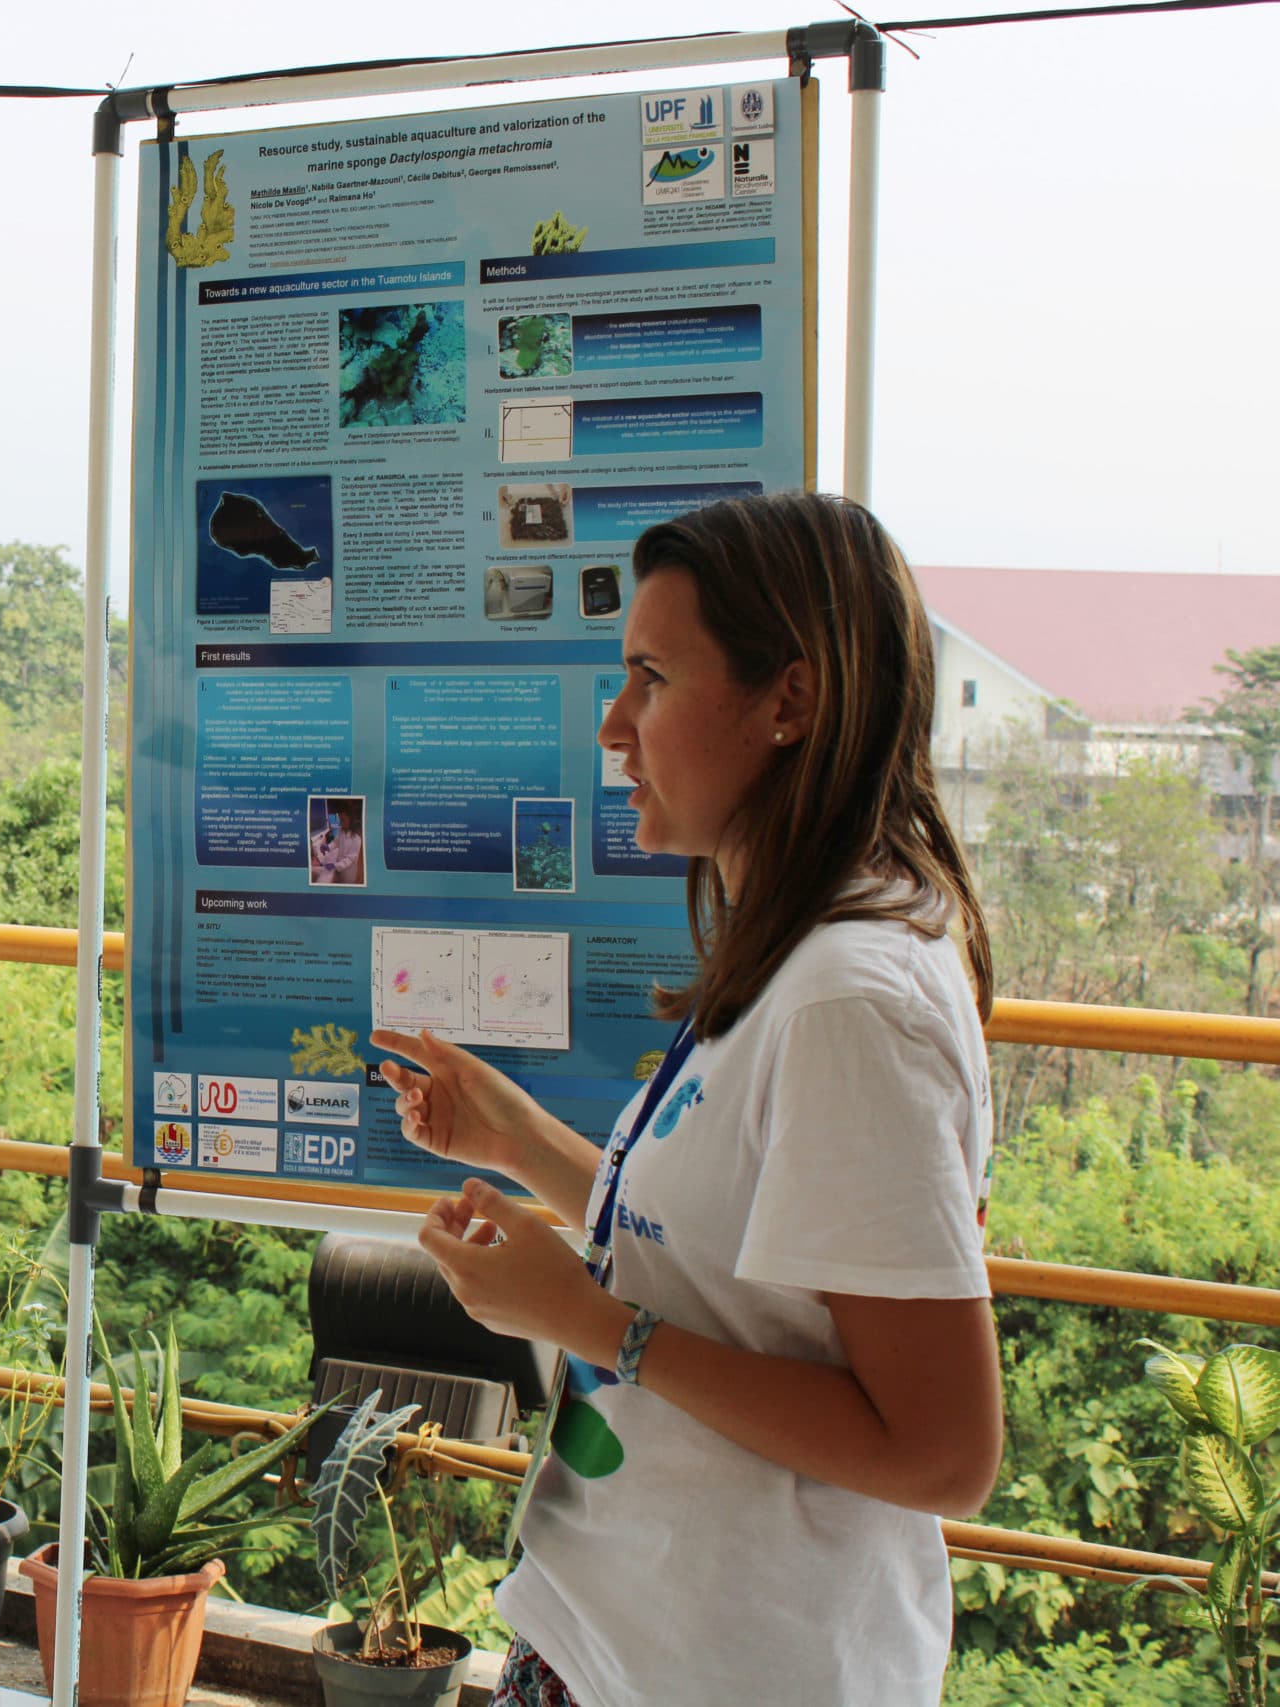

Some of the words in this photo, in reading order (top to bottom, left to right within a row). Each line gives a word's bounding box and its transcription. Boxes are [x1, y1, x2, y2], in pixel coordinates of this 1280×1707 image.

[646, 98, 686, 122] UPF
[258, 141, 308, 157] Resource
[311, 138, 343, 154] study,
[345, 131, 408, 148] sustainable
[411, 125, 477, 144] aquaculture
[480, 122, 500, 135] and
[503, 115, 569, 132] valorization
[572, 114, 585, 126] of
[587, 112, 605, 124] the
[307, 158, 344, 172] marine
[347, 157, 386, 171] sponge
[389, 146, 476, 167] Dactylospongia
[478, 139, 552, 156] metachromia
[250, 187, 280, 198] Mathilde
[468, 167, 500, 180] Georges
[250, 200, 272, 210] Nicole
[274, 199, 284, 208] De
[329, 192, 360, 203] Raimana
[486, 264, 526, 276] Methods
[205, 286, 240, 298] Towards
[242, 288, 247, 296] a
[250, 286, 267, 295] new
[269, 280, 319, 296] aquaculture
[322, 278, 348, 289] sector
[351, 277, 358, 287] in
[361, 276, 375, 286] the
[378, 273, 417, 285] Tuamotu
[419, 270, 451, 282] Islands
[482, 510, 495, 521] III.
[201, 652, 221, 661] First
[222, 652, 251, 661] results
[201, 898, 244, 910] Upcoming
[246, 899, 268, 909] work
[306, 1097, 350, 1108] LEMAR
[304, 1134, 356, 1166] EDP
